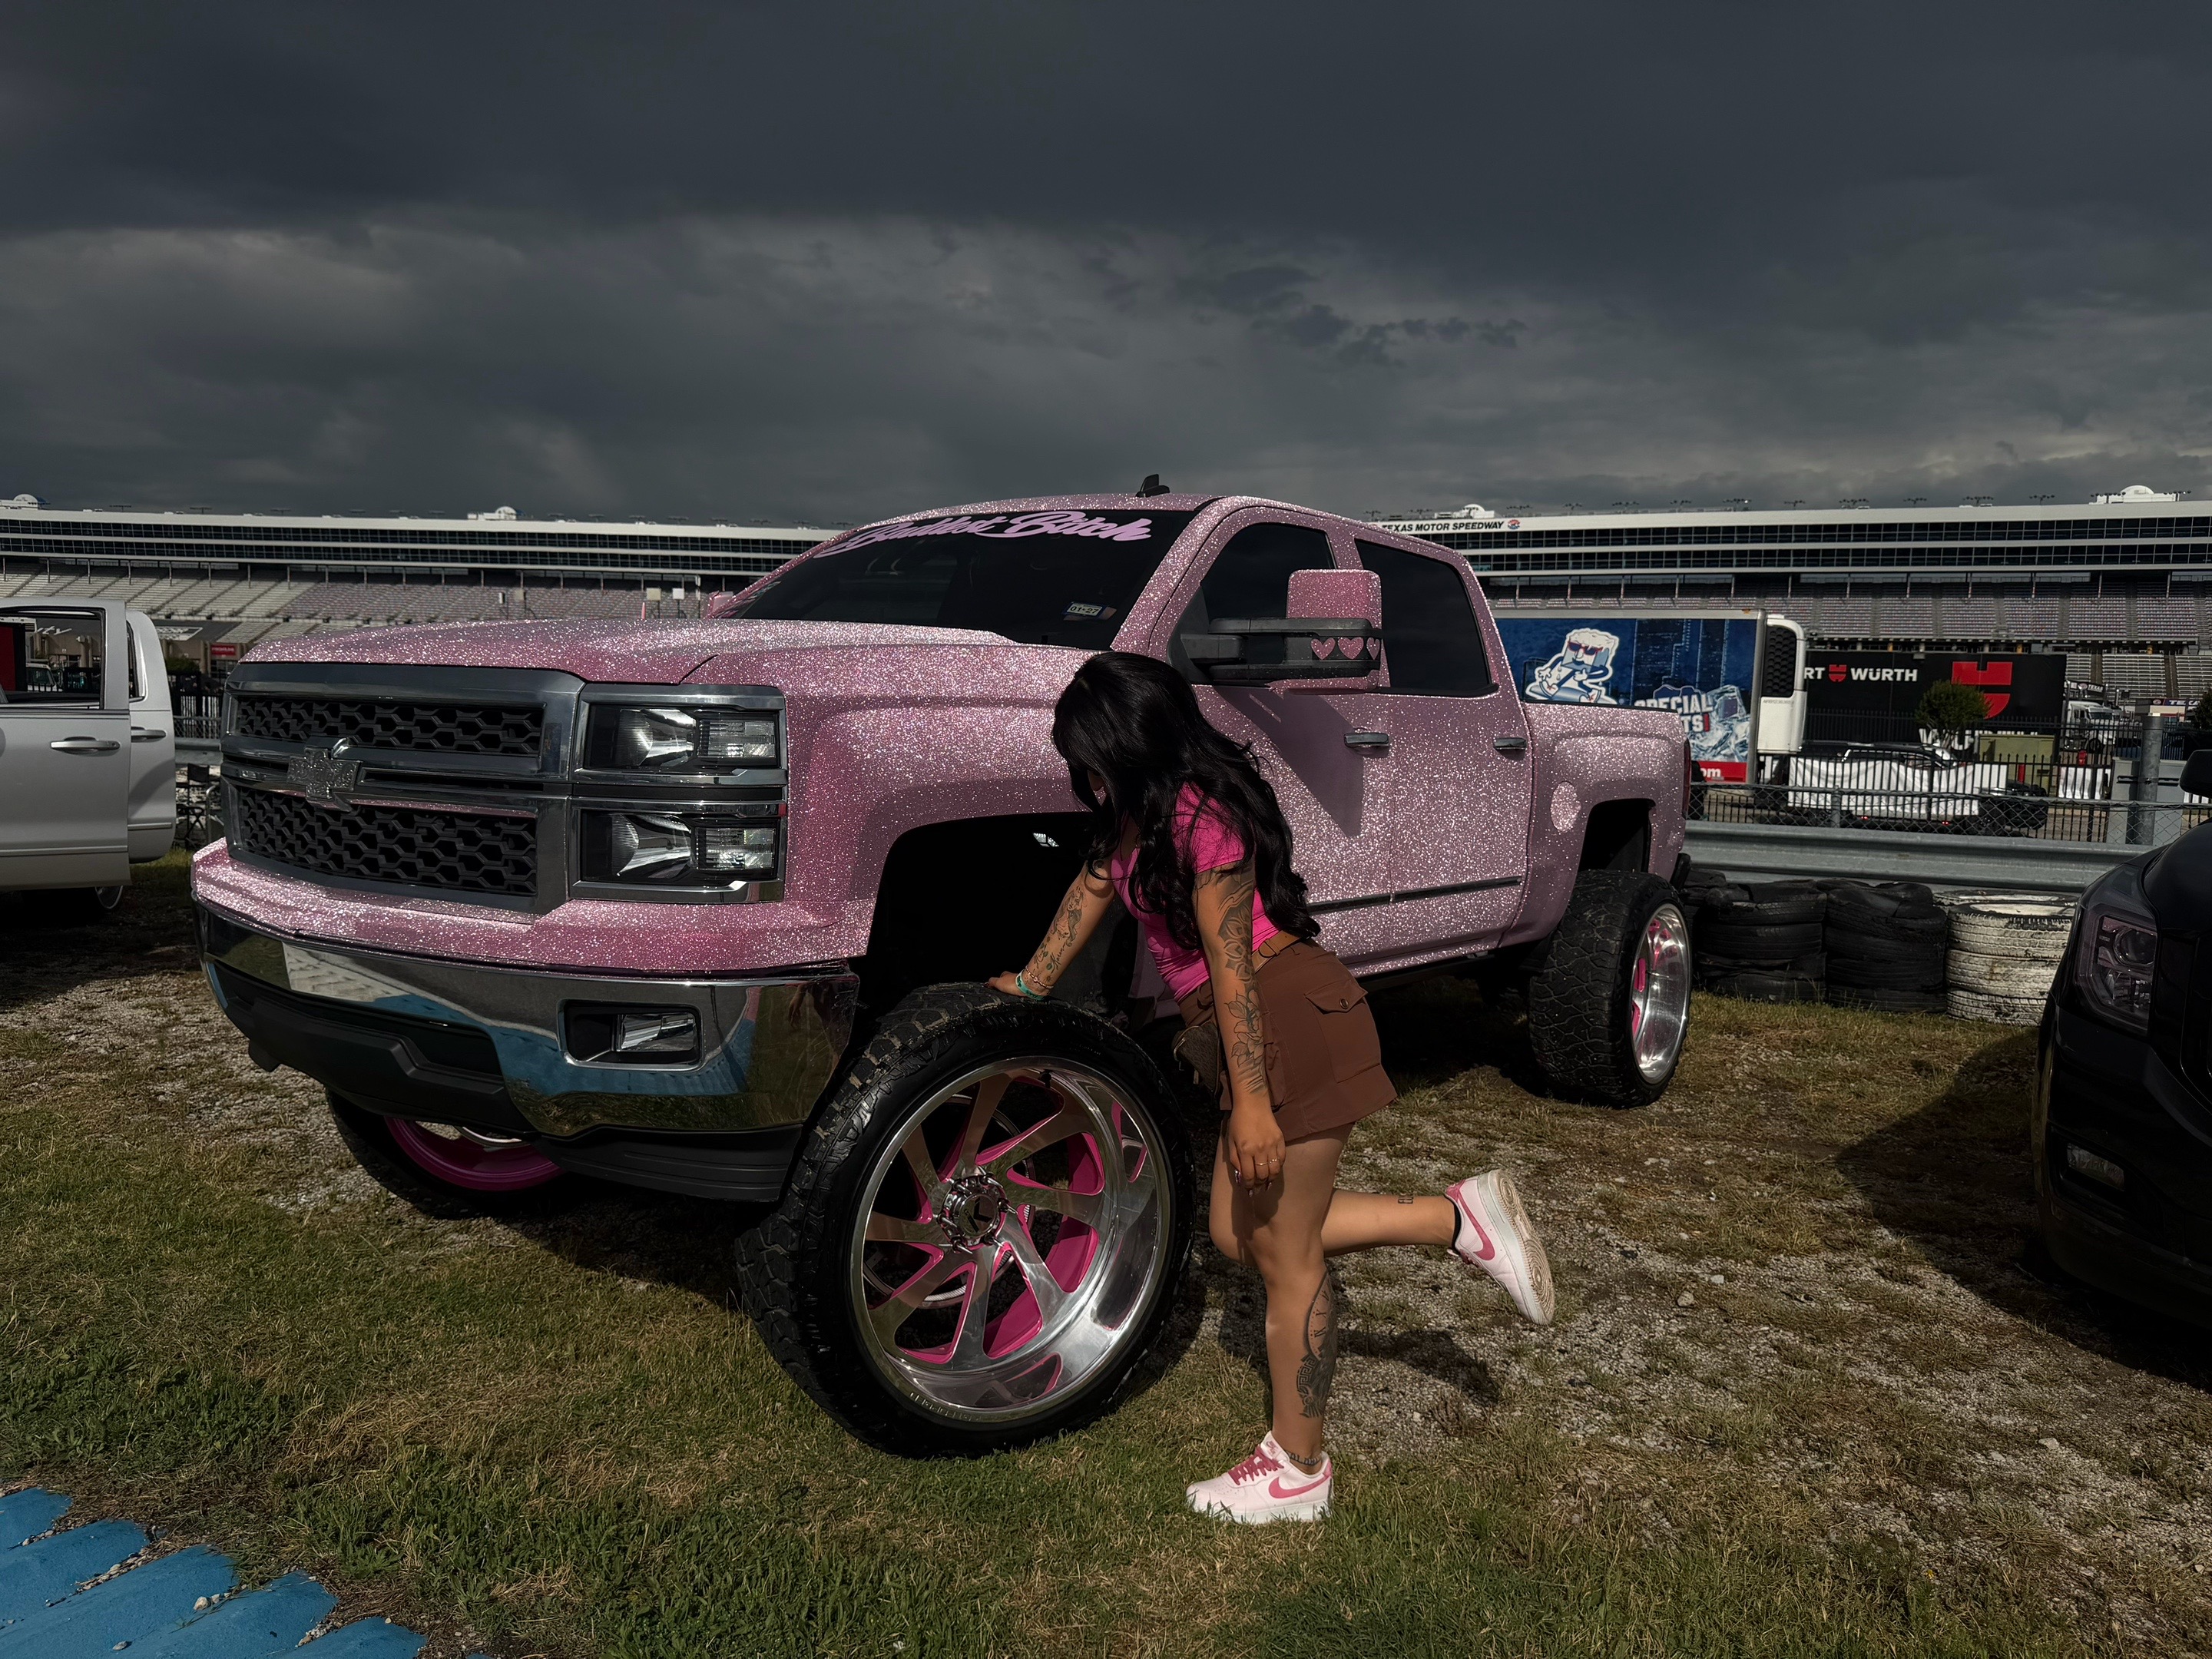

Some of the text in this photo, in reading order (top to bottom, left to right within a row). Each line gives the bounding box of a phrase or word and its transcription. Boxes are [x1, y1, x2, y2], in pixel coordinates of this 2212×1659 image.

[974, 510, 1153, 541] Bitch
[1415, 523, 1449, 531] MOTOR
[1452, 521, 1505, 531] SPEEDWAY
[1804, 667, 1919, 682] RT WÜRTH
